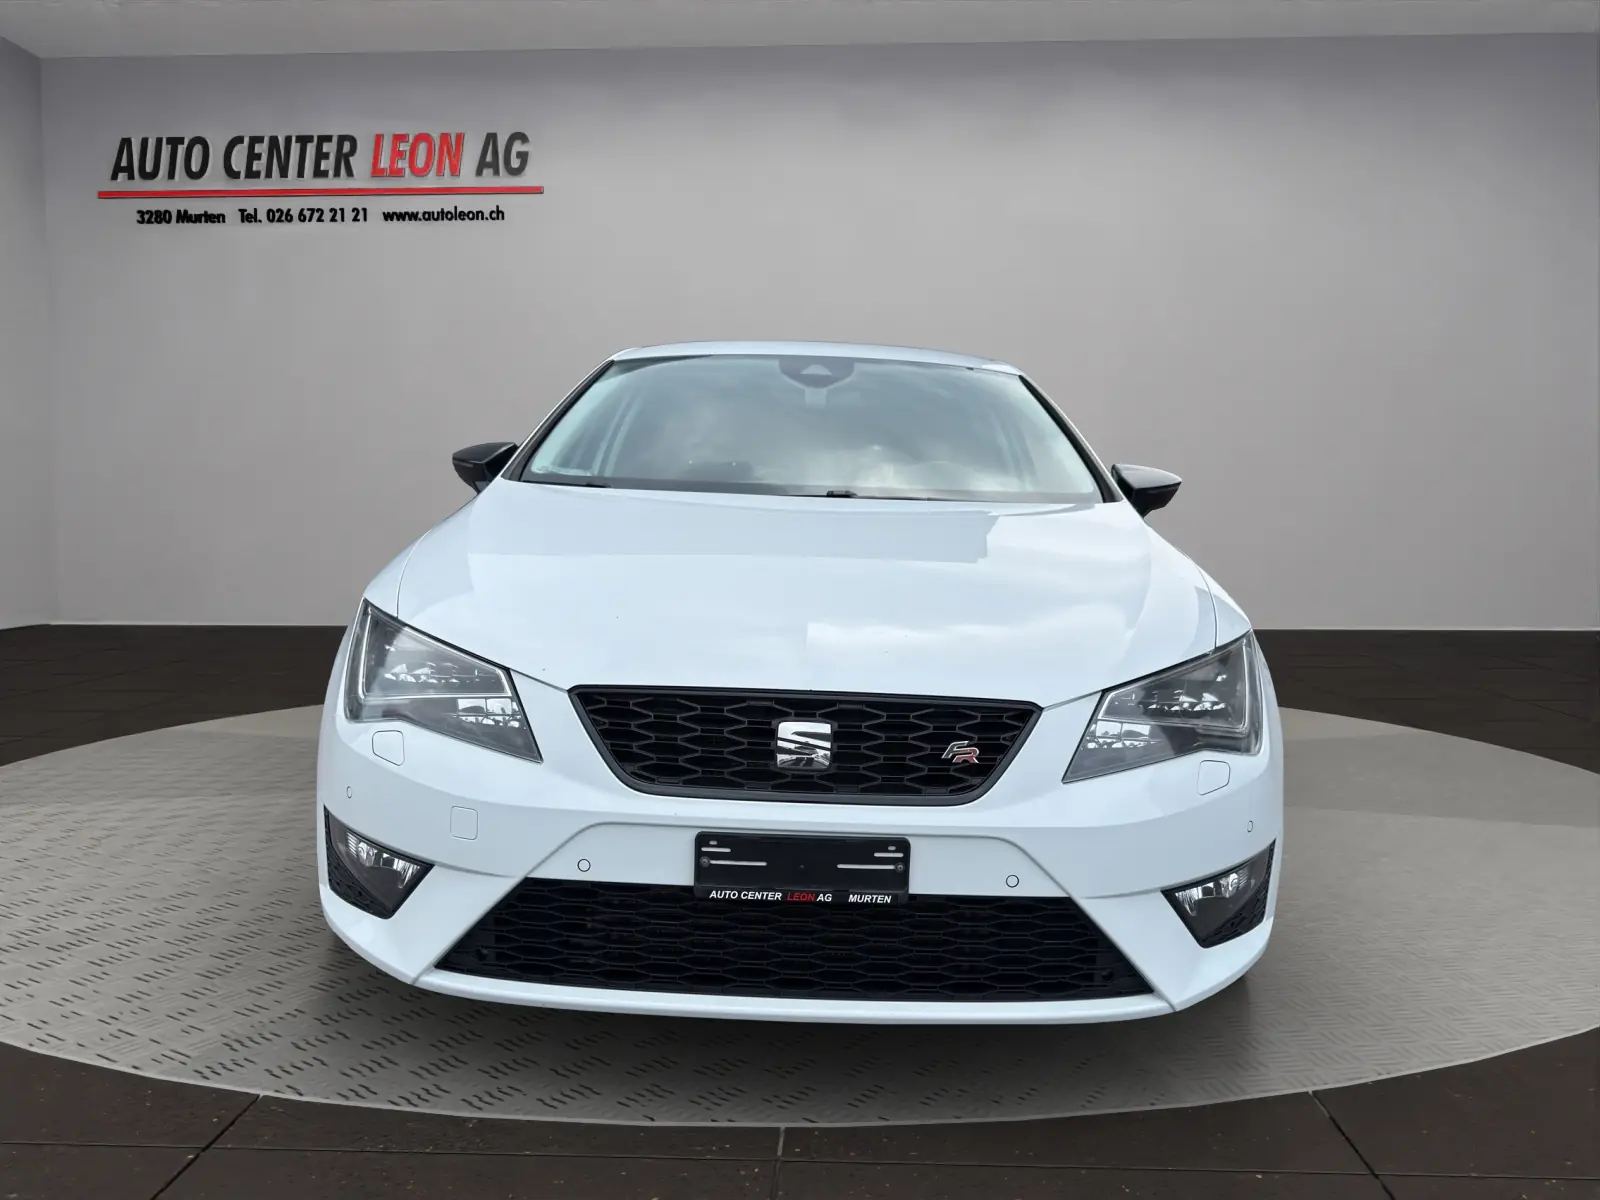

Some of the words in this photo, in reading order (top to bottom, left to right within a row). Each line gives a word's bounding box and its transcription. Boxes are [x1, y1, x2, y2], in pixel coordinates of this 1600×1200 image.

[110, 136, 210, 181] AUTO
[223, 134, 358, 180] CENTER
[370, 132, 465, 177] LEON
[475, 131, 530, 177] AG
[136, 209, 173, 225] 3280
[176, 209, 226, 224] Murten
[239, 208, 262, 224] Tel.
[266, 208, 294, 223] 026
[297, 208, 326, 223] 672
[329, 207, 346, 222] 21
[351, 207, 368, 222] 21
[382, 205, 506, 222] www.autoleon.ch
[709, 890, 738, 900] AUTO
[740, 891, 782, 901] CENTER
[786, 892, 815, 902] LEON
[816, 893, 832, 902] AG
[848, 894, 892, 904] MURTEN
